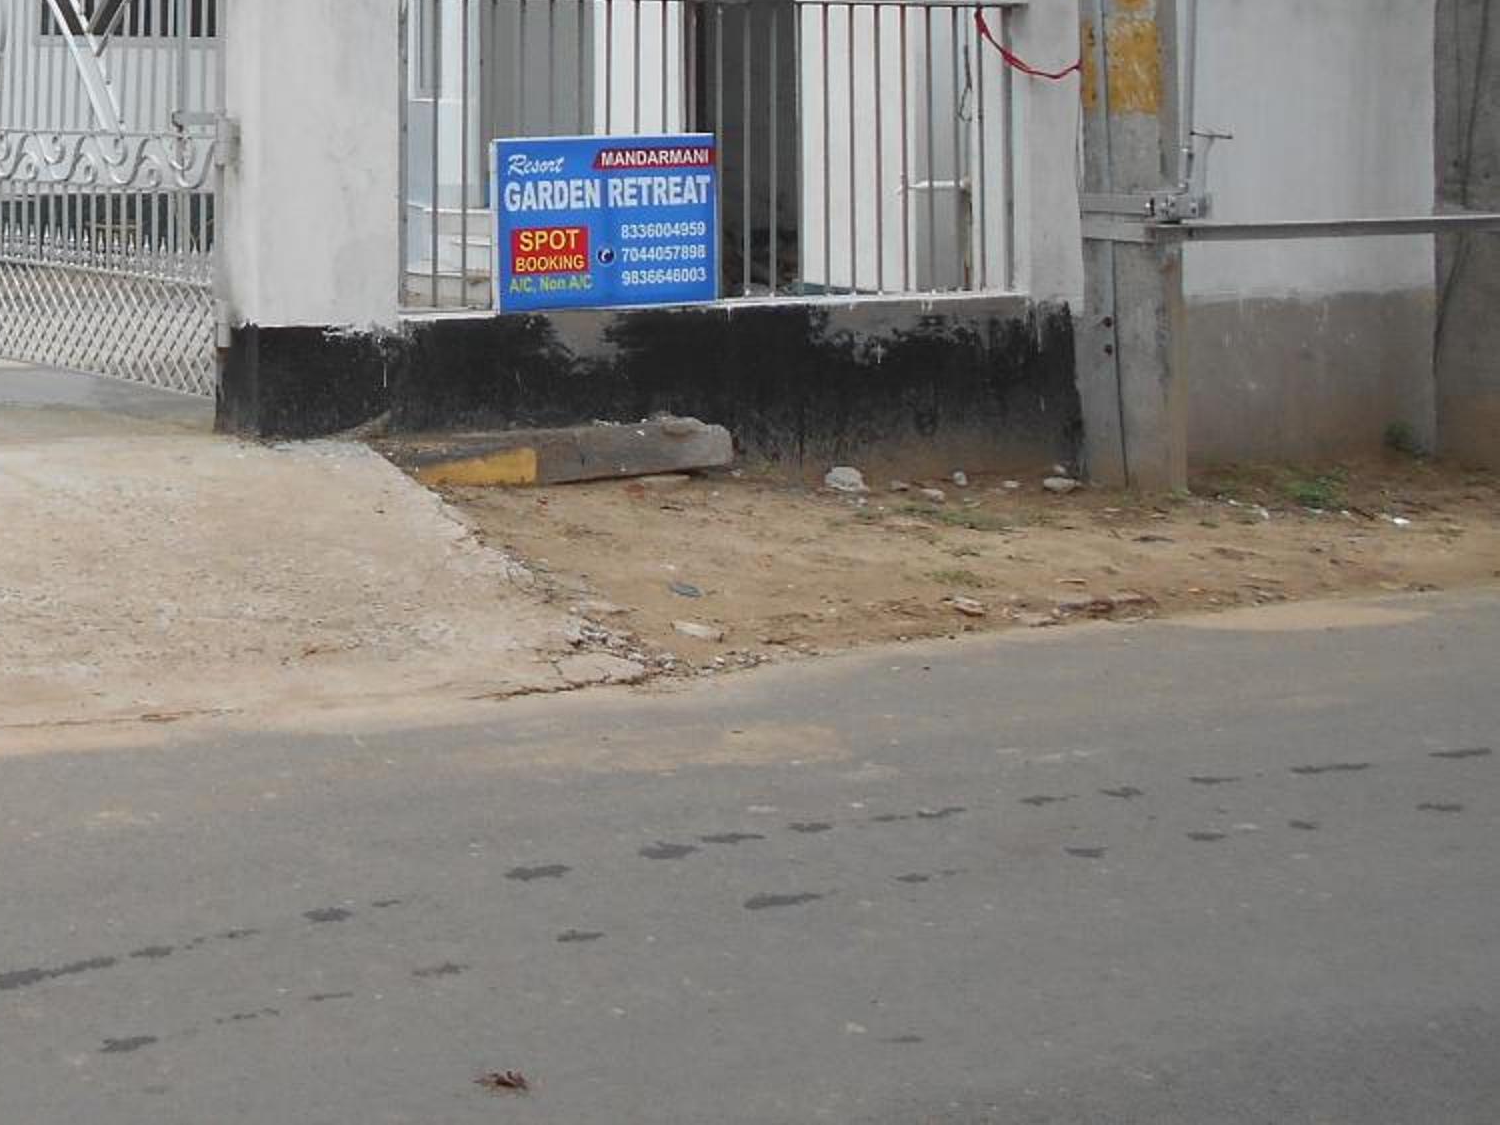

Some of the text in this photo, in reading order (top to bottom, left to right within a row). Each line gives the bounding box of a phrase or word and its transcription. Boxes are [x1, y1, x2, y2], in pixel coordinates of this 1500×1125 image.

[507, 154, 564, 176] Resort
[601, 149, 709, 167] MANDARMANI
[504, 175, 711, 212] GARDEN RETREAT
[519, 229, 580, 251] SPOT
[515, 255, 585, 272] BOOKING
